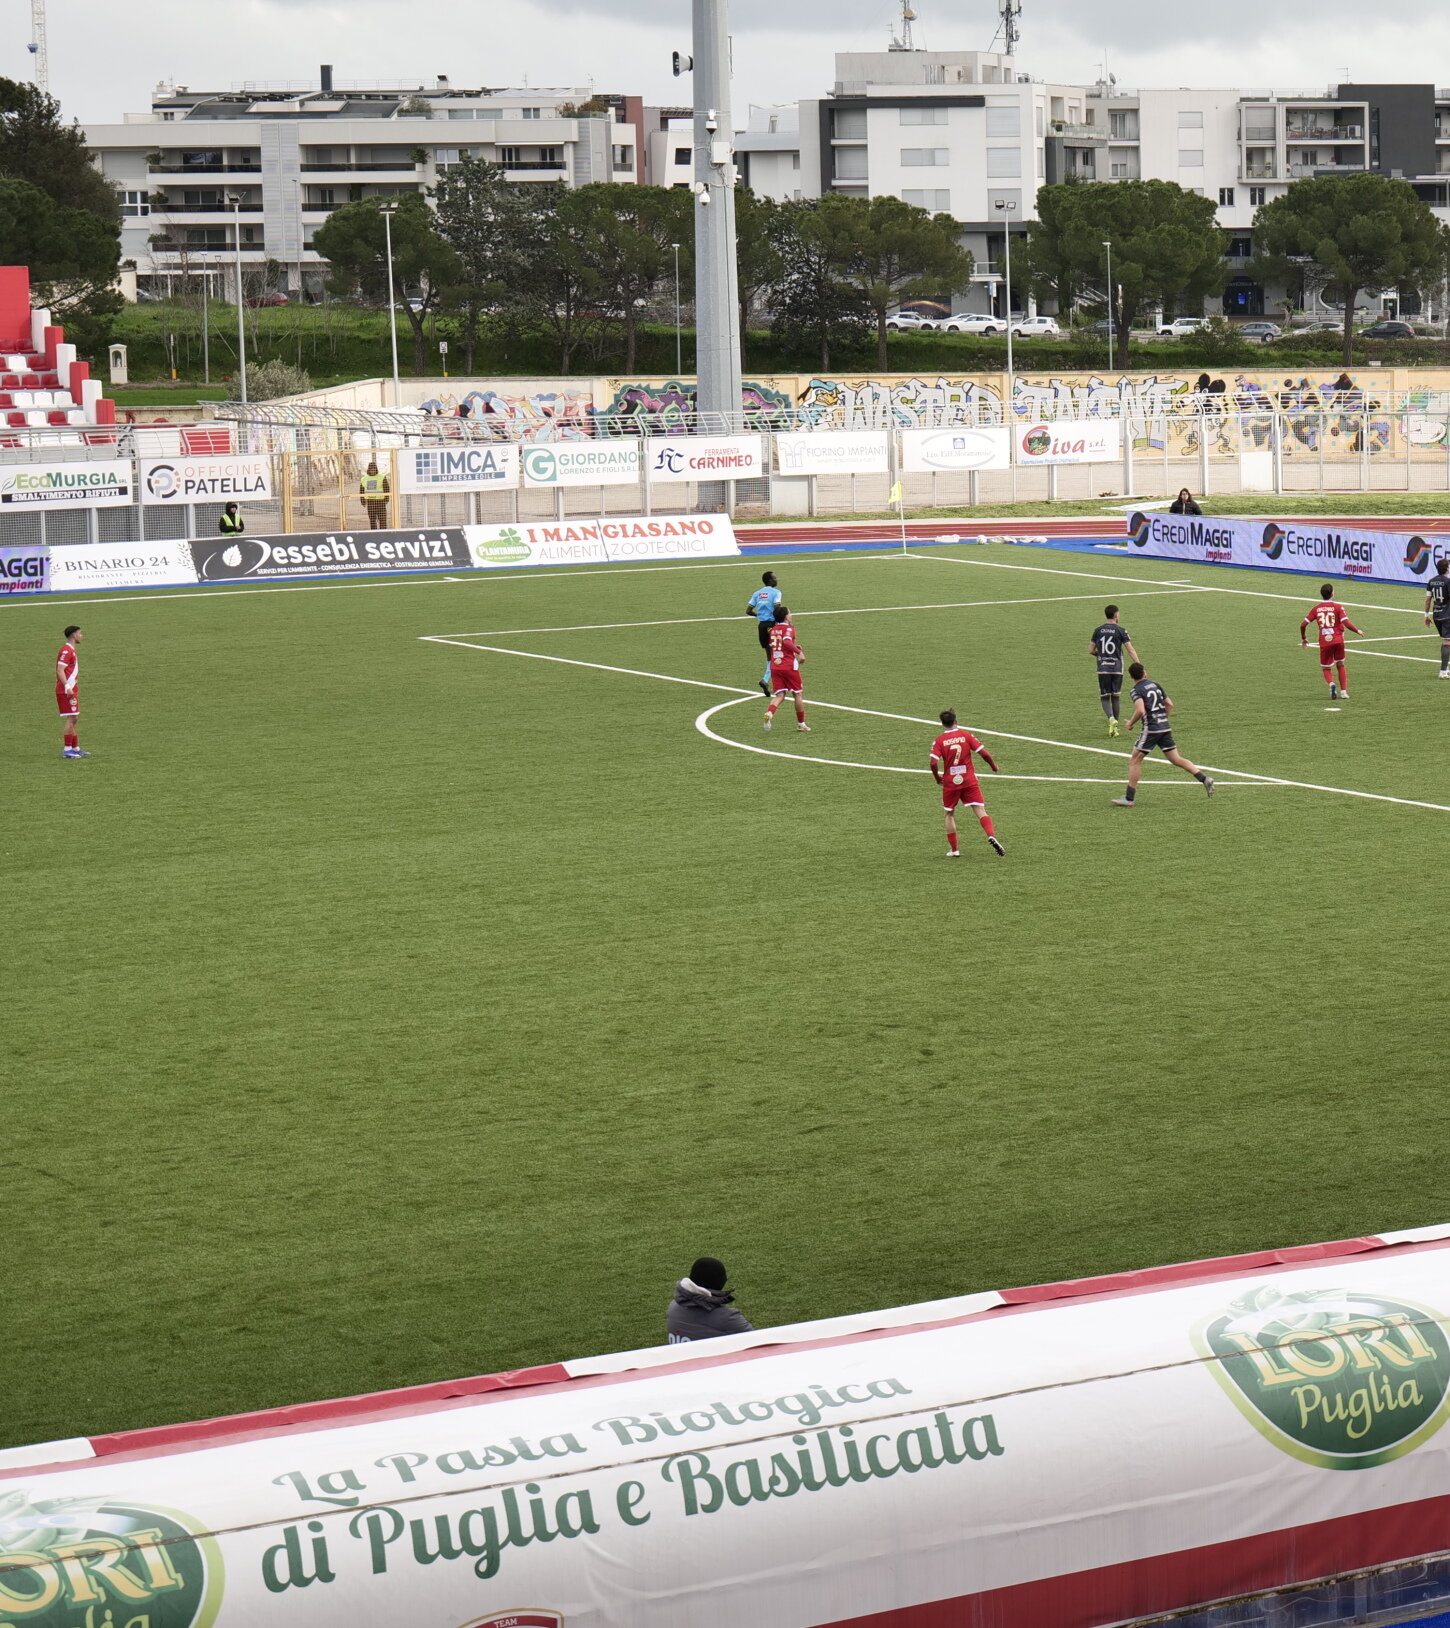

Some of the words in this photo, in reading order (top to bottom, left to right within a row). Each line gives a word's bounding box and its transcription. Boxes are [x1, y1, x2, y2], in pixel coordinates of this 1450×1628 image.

[559, 452, 638, 466] GIORDANO
[704, 448, 740, 456] FERRAMENTA
[806, 447, 845, 457] FIORINO
[848, 446, 887, 456] IMPIANTI
[184, 464, 261, 477] OFFICINE
[440, 450, 497, 474] IMCA
[689, 455, 753, 469] CARNIMEO
[184, 476, 266, 495] PATELLA
[11, 490, 84, 501] SMALTIMENTO
[85, 488, 120, 497] RIFIUTI
[526, 528, 539, 543] I
[541, 520, 714, 543] MANGIASANO
[364, 532, 453, 559] servizi
[539, 545, 602, 560] ALIMENTI
[610, 539, 707, 556] ZOOTECNICI
[64, 557, 145, 572] BINARIO
[149, 556, 170, 567] 24
[1205, 549, 1232, 562] impianti
[1343, 562, 1373, 575] impianti
[1431, 587, 1445, 603] 14
[1317, 612, 1336, 627] 30
[1099, 635, 1116, 655] 16
[1146, 689, 1166, 712] 23
[949, 744, 962, 765] 7
[1221, 1313, 1438, 1388] LORI
[1291, 1371, 1424, 1439] Puglia
[271, 1469, 367, 1507] La
[374, 1432, 588, 1483] Pasta
[592, 1378, 913, 1446] Biologica
[261, 1520, 336, 1594] di
[349, 1482, 601, 1580] Puglia
[615, 1480, 652, 1527] e
[661, 1411, 1005, 1517] Basilicata
[493, 1618, 518, 1628] TEAM
